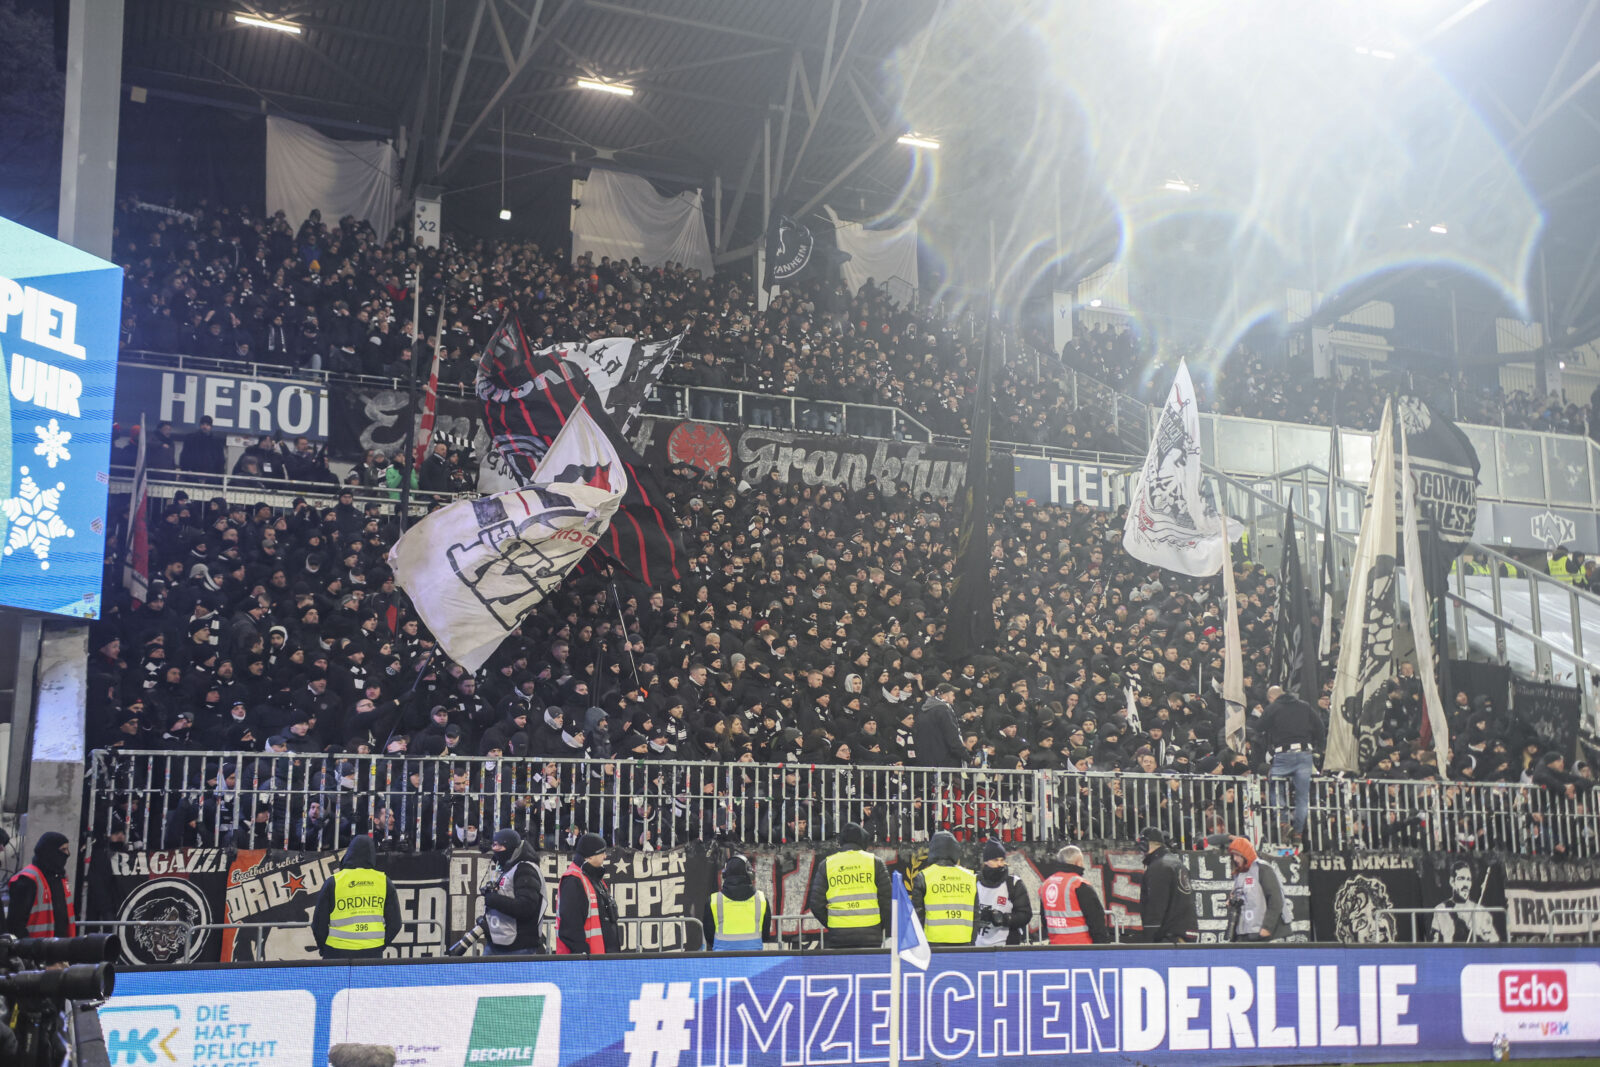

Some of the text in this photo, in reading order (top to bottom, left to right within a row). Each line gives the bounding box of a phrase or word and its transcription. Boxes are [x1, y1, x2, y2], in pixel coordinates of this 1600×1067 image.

[419, 220, 436, 232] X2
[10, 352, 83, 418] UHR
[110, 848, 228, 876] RAGAZZI
[632, 850, 686, 879] DER
[231, 862, 274, 884] Football
[829, 873, 873, 888] ORDNER
[931, 883, 971, 894] ORDNER
[337, 896, 385, 911] ORDNER
[946, 911, 962, 919] 199
[355, 924, 369, 932] 396
[1504, 973, 1564, 1007] Echo
[196, 1004, 231, 1022] DIE
[622, 963, 1419, 1067] #IMZEICHENDERLILIE
[194, 1023, 252, 1041] HAFT
[1541, 1021, 1569, 1036] VRM
[193, 1041, 278, 1061] PFLICHT
[469, 1046, 534, 1062] BECHTLE
